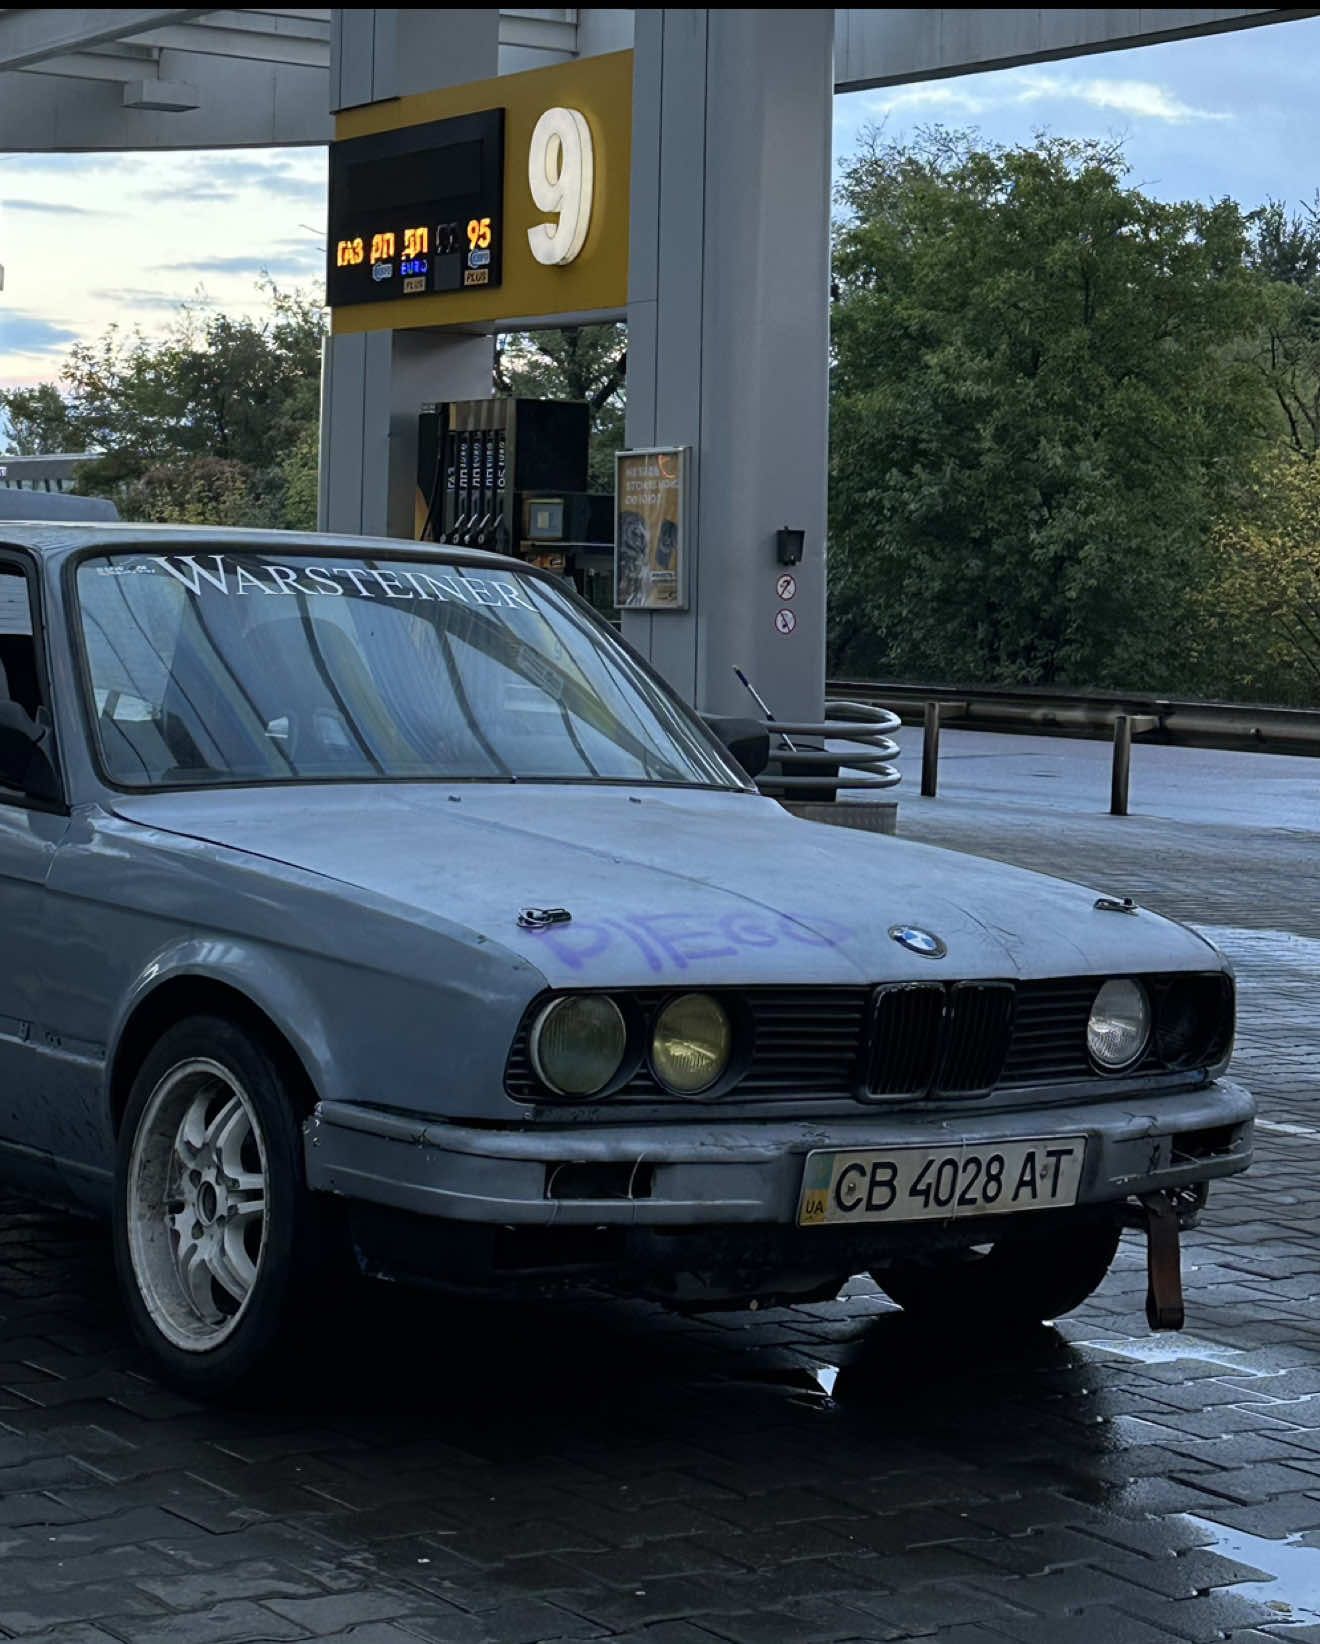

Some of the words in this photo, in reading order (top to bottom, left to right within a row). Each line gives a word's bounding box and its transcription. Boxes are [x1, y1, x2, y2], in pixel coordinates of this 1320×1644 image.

[528, 106, 594, 266] 9
[336, 237, 364, 267] ГАЗ
[467, 217, 491, 250] 95
[149, 555, 538, 612] WARSTEINER
[805, 1199, 825, 1214] UA
[834, 1161, 898, 1212] CB
[908, 1154, 1005, 1208] 4028
[1012, 1149, 1074, 1202] AT
